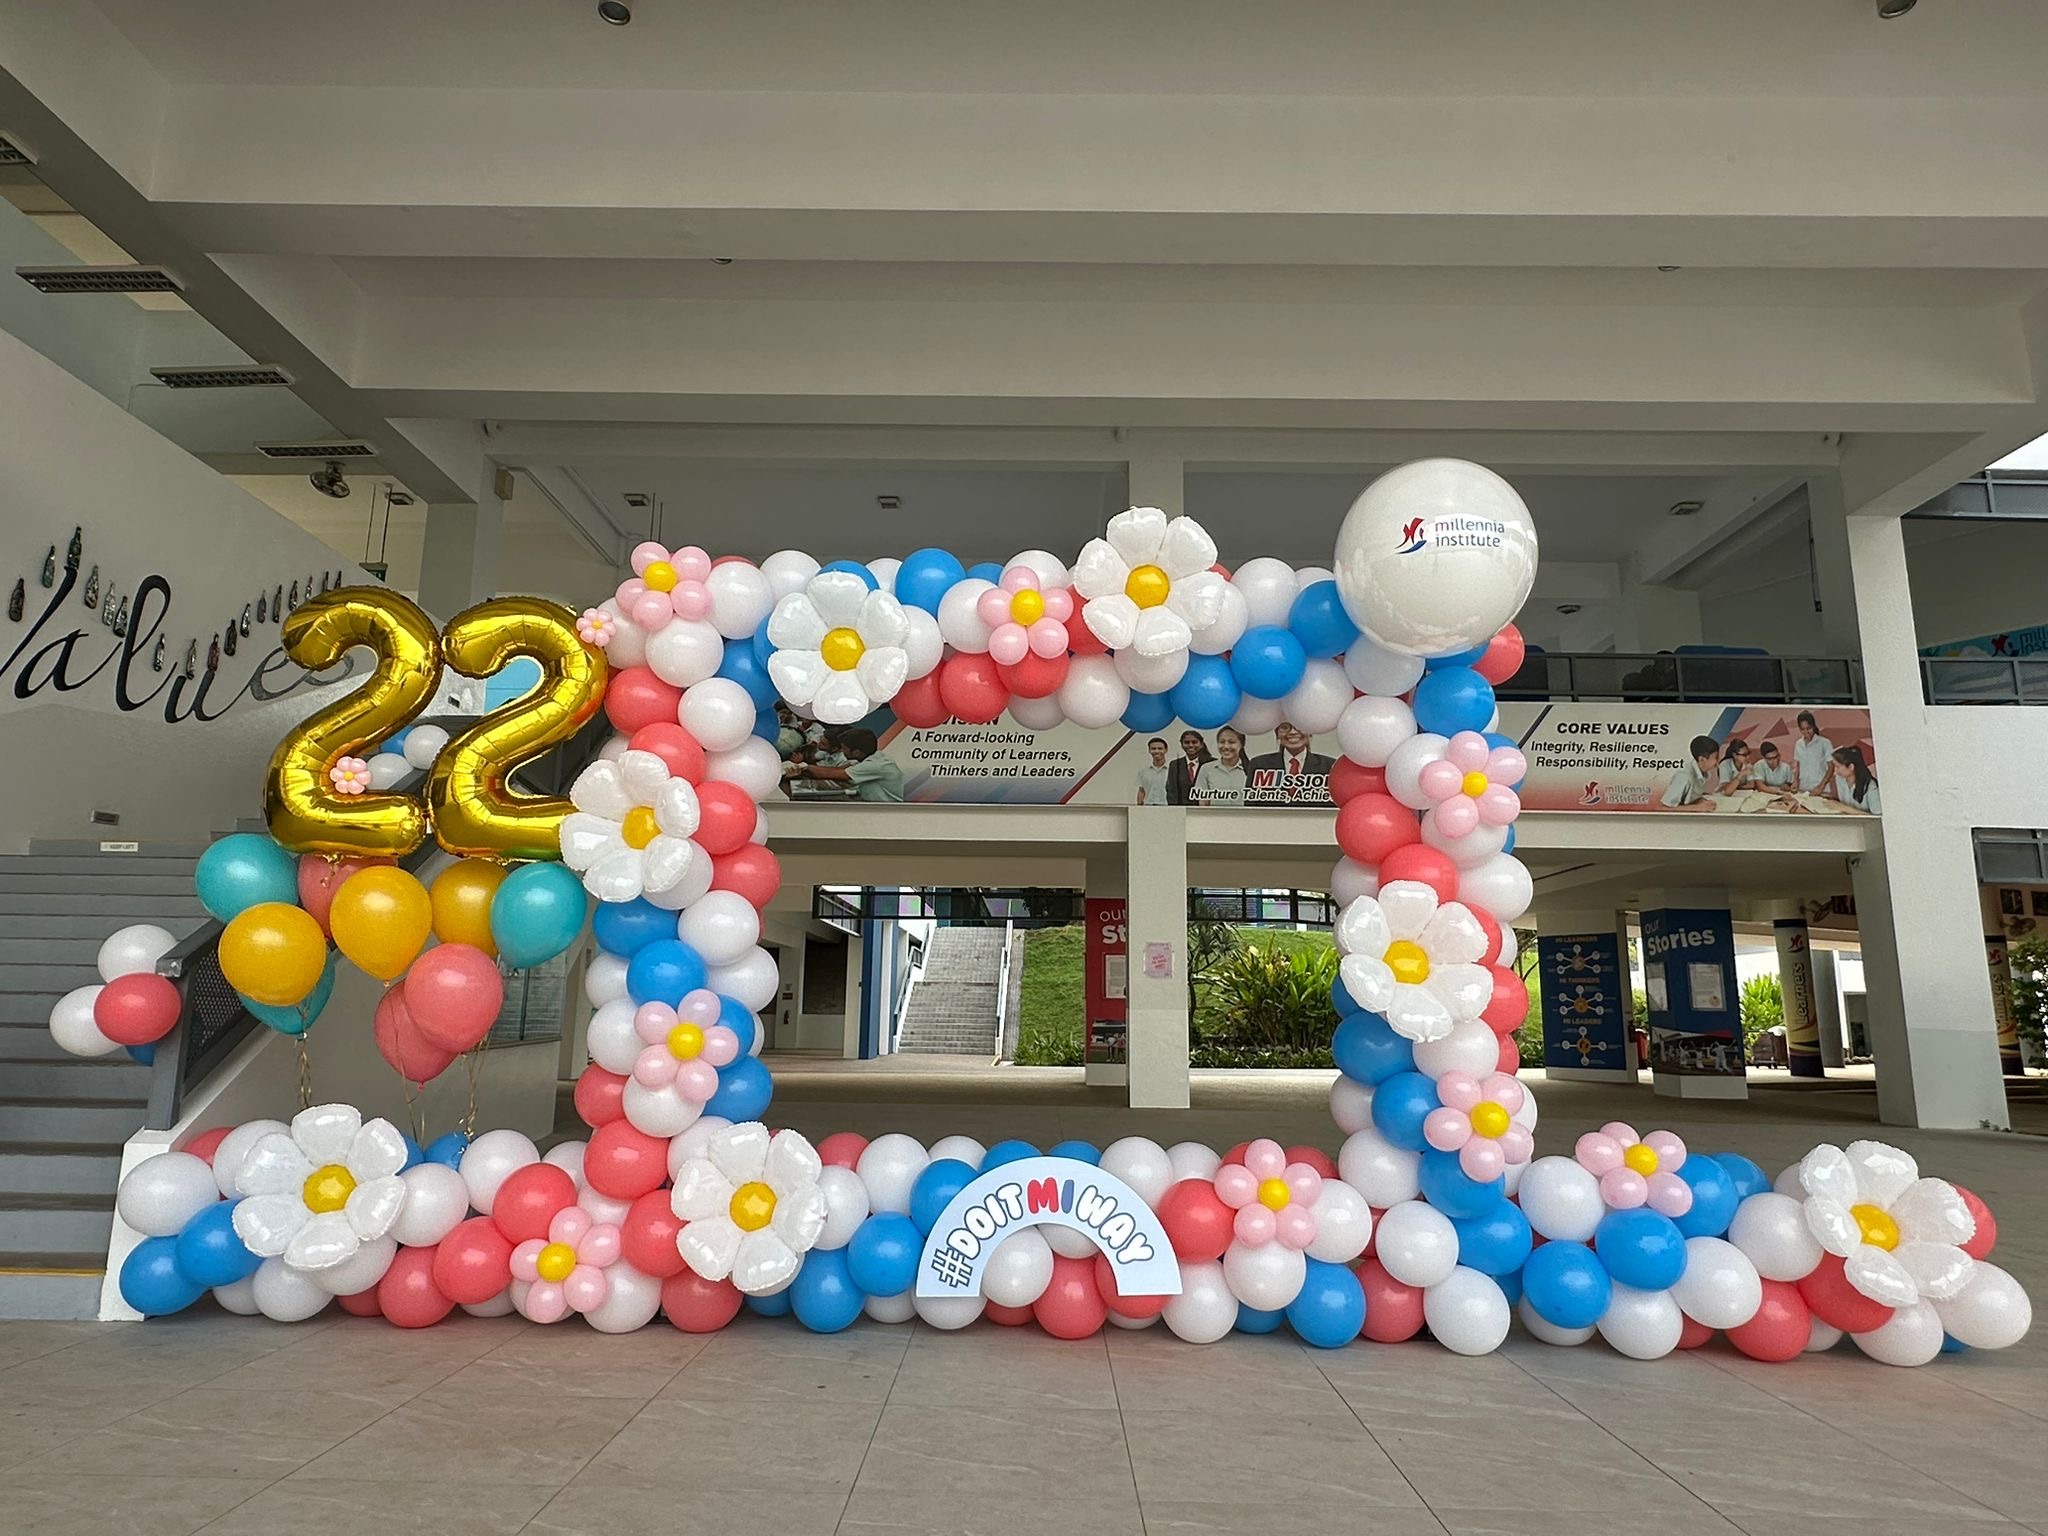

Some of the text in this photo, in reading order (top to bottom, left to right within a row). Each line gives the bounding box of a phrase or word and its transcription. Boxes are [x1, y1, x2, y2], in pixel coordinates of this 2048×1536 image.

[1434, 518, 1505, 534] millennia
[1435, 533, 1501, 548] institute
[1557, 722, 1670, 735] CORE VALUES
[911, 731, 1035, 746] A Forward-looking
[1531, 741, 1658, 754] Integrity, Resilience,
[911, 748, 1072, 762] Community of Learners,
[931, 764, 1076, 777] Thinkers and Leaders
[1536, 756, 1684, 771] Responsibility, Respect
[1190, 788, 1332, 802] Nurture Talents, Achie
[1604, 785, 1651, 794] millennia
[1605, 794, 1649, 803] institute
[1645, 919, 1660, 934] our
[1647, 927, 1716, 956] Stories
[1794, 962, 1809, 1025] Learners
